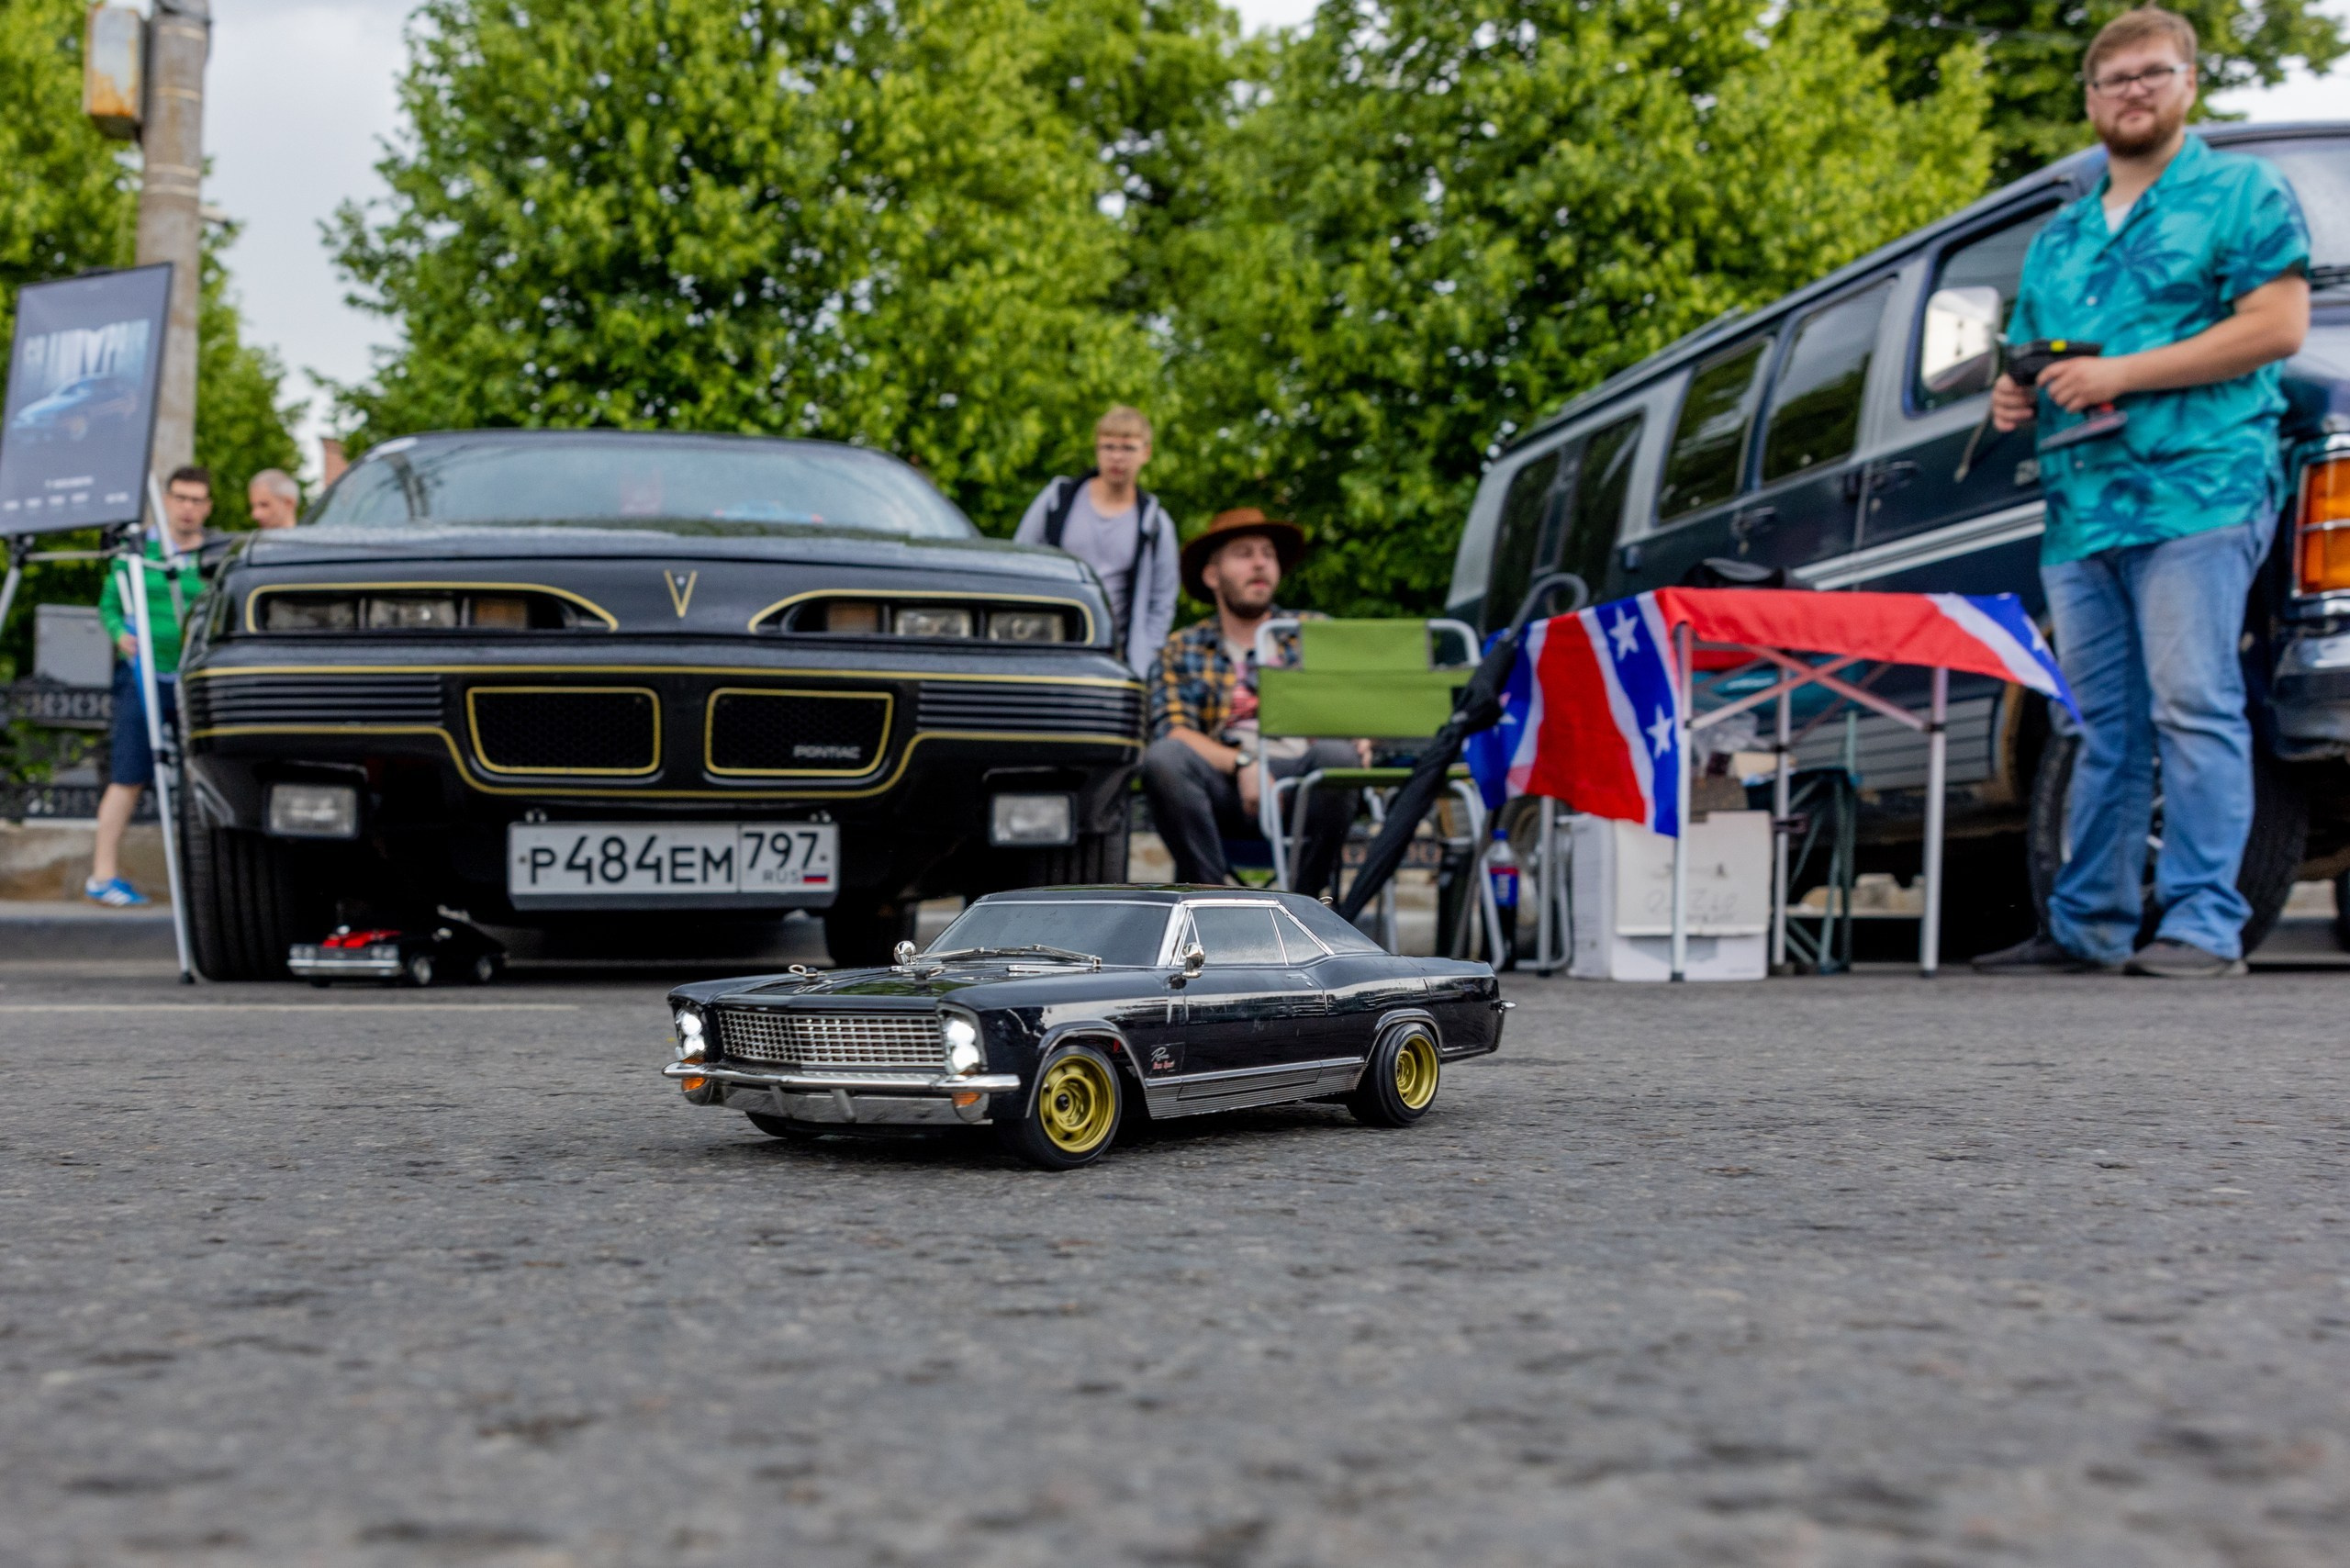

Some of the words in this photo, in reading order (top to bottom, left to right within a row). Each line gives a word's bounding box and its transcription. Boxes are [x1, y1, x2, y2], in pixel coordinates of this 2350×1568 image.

[793, 745, 861, 759] PONTIAC
[743, 832, 819, 869] 797
[763, 869, 800, 884] RUS
